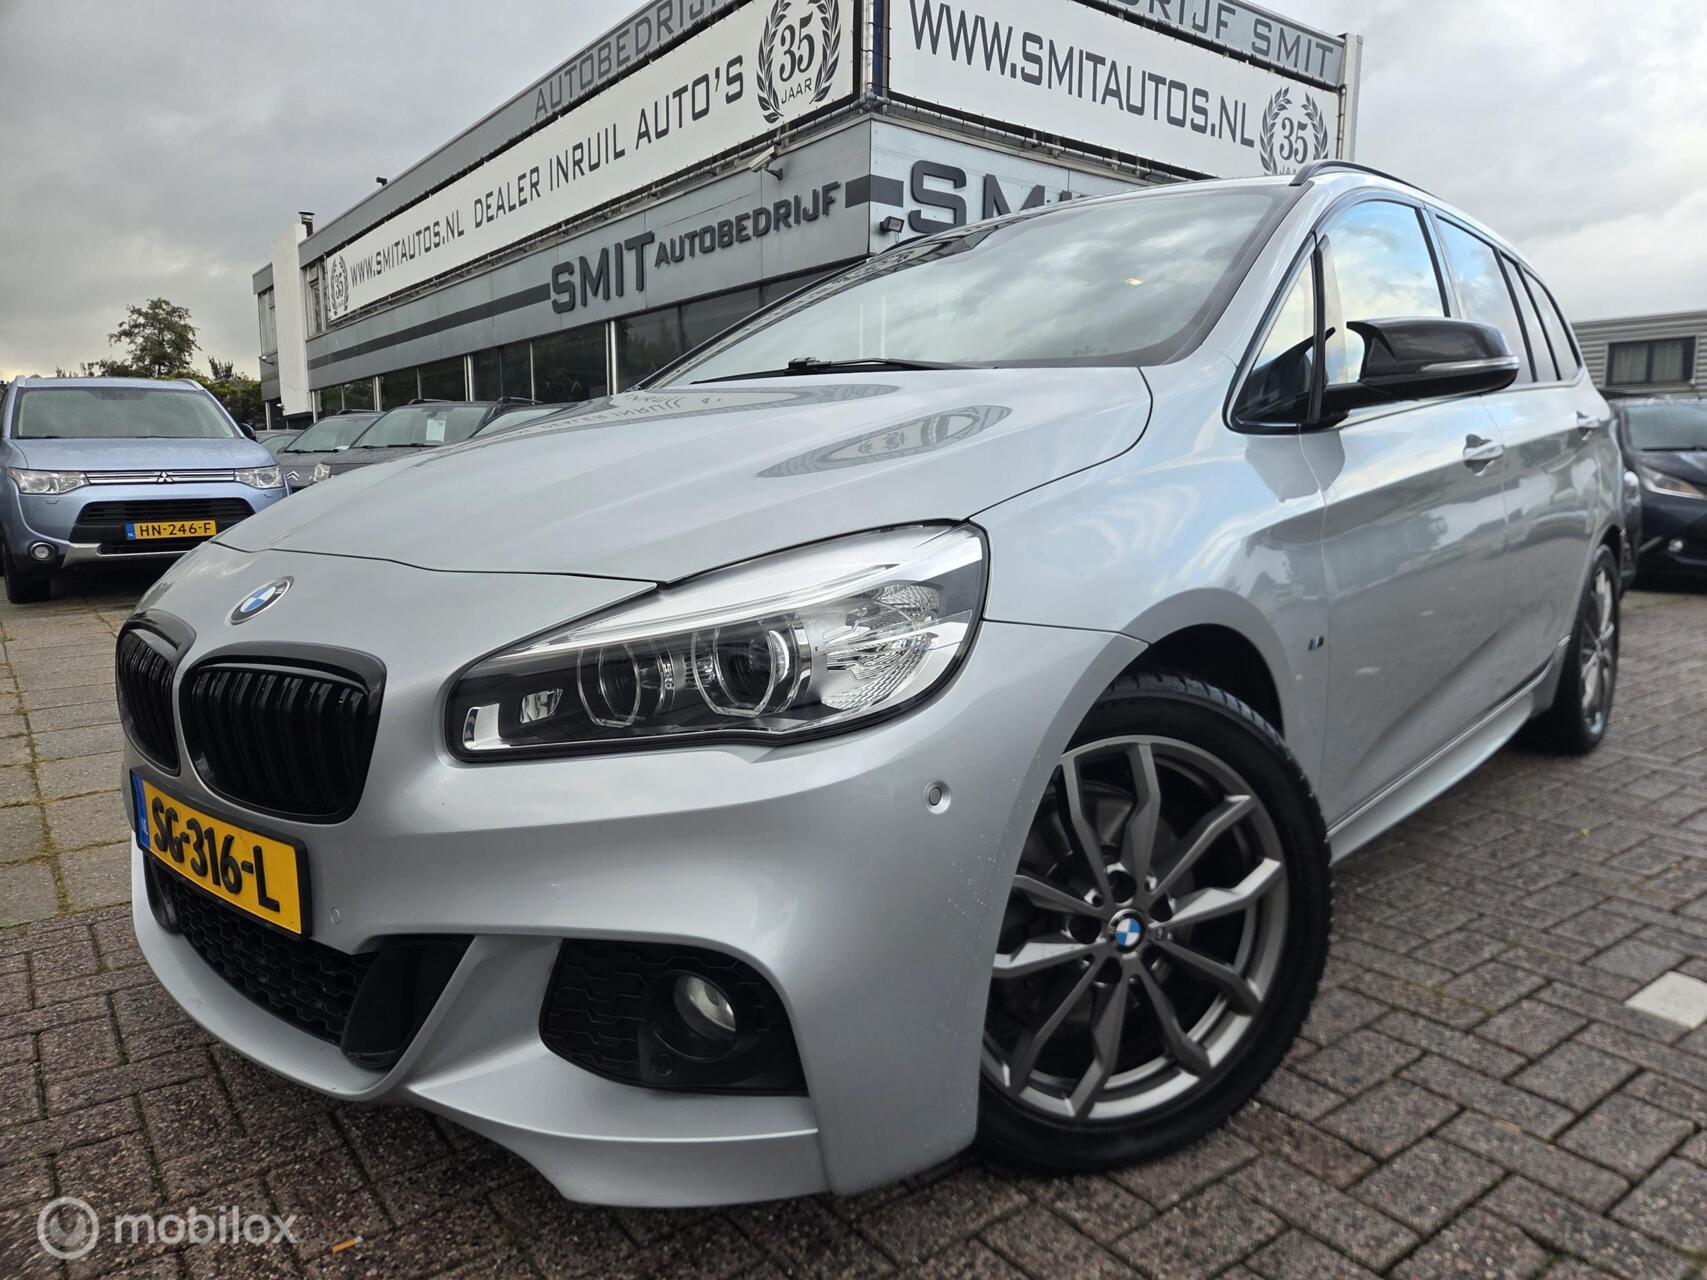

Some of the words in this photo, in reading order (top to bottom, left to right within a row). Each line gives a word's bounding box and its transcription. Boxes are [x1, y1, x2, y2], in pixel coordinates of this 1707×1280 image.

[534, 0, 716, 120] AUTOBEDRIJ
[779, 11, 815, 82] 35
[781, 77, 812, 105] JAAR
[909, 0, 1255, 148] WWW.SMITAUTOS.NL
[1251, 18, 1334, 78] SMIT
[350, 210, 465, 288] WWW.SMITAUTOS.NL
[473, 166, 541, 229] DEALER
[549, 123, 626, 192] INRUIL
[635, 55, 744, 150] AUTO'S
[1279, 117, 1309, 164] 35
[551, 231, 655, 314] SMIT
[654, 181, 841, 268] AUTOBEDRIJF
[139, 522, 211, 537] HN-246-F
[151, 796, 281, 913] SG-316-L
